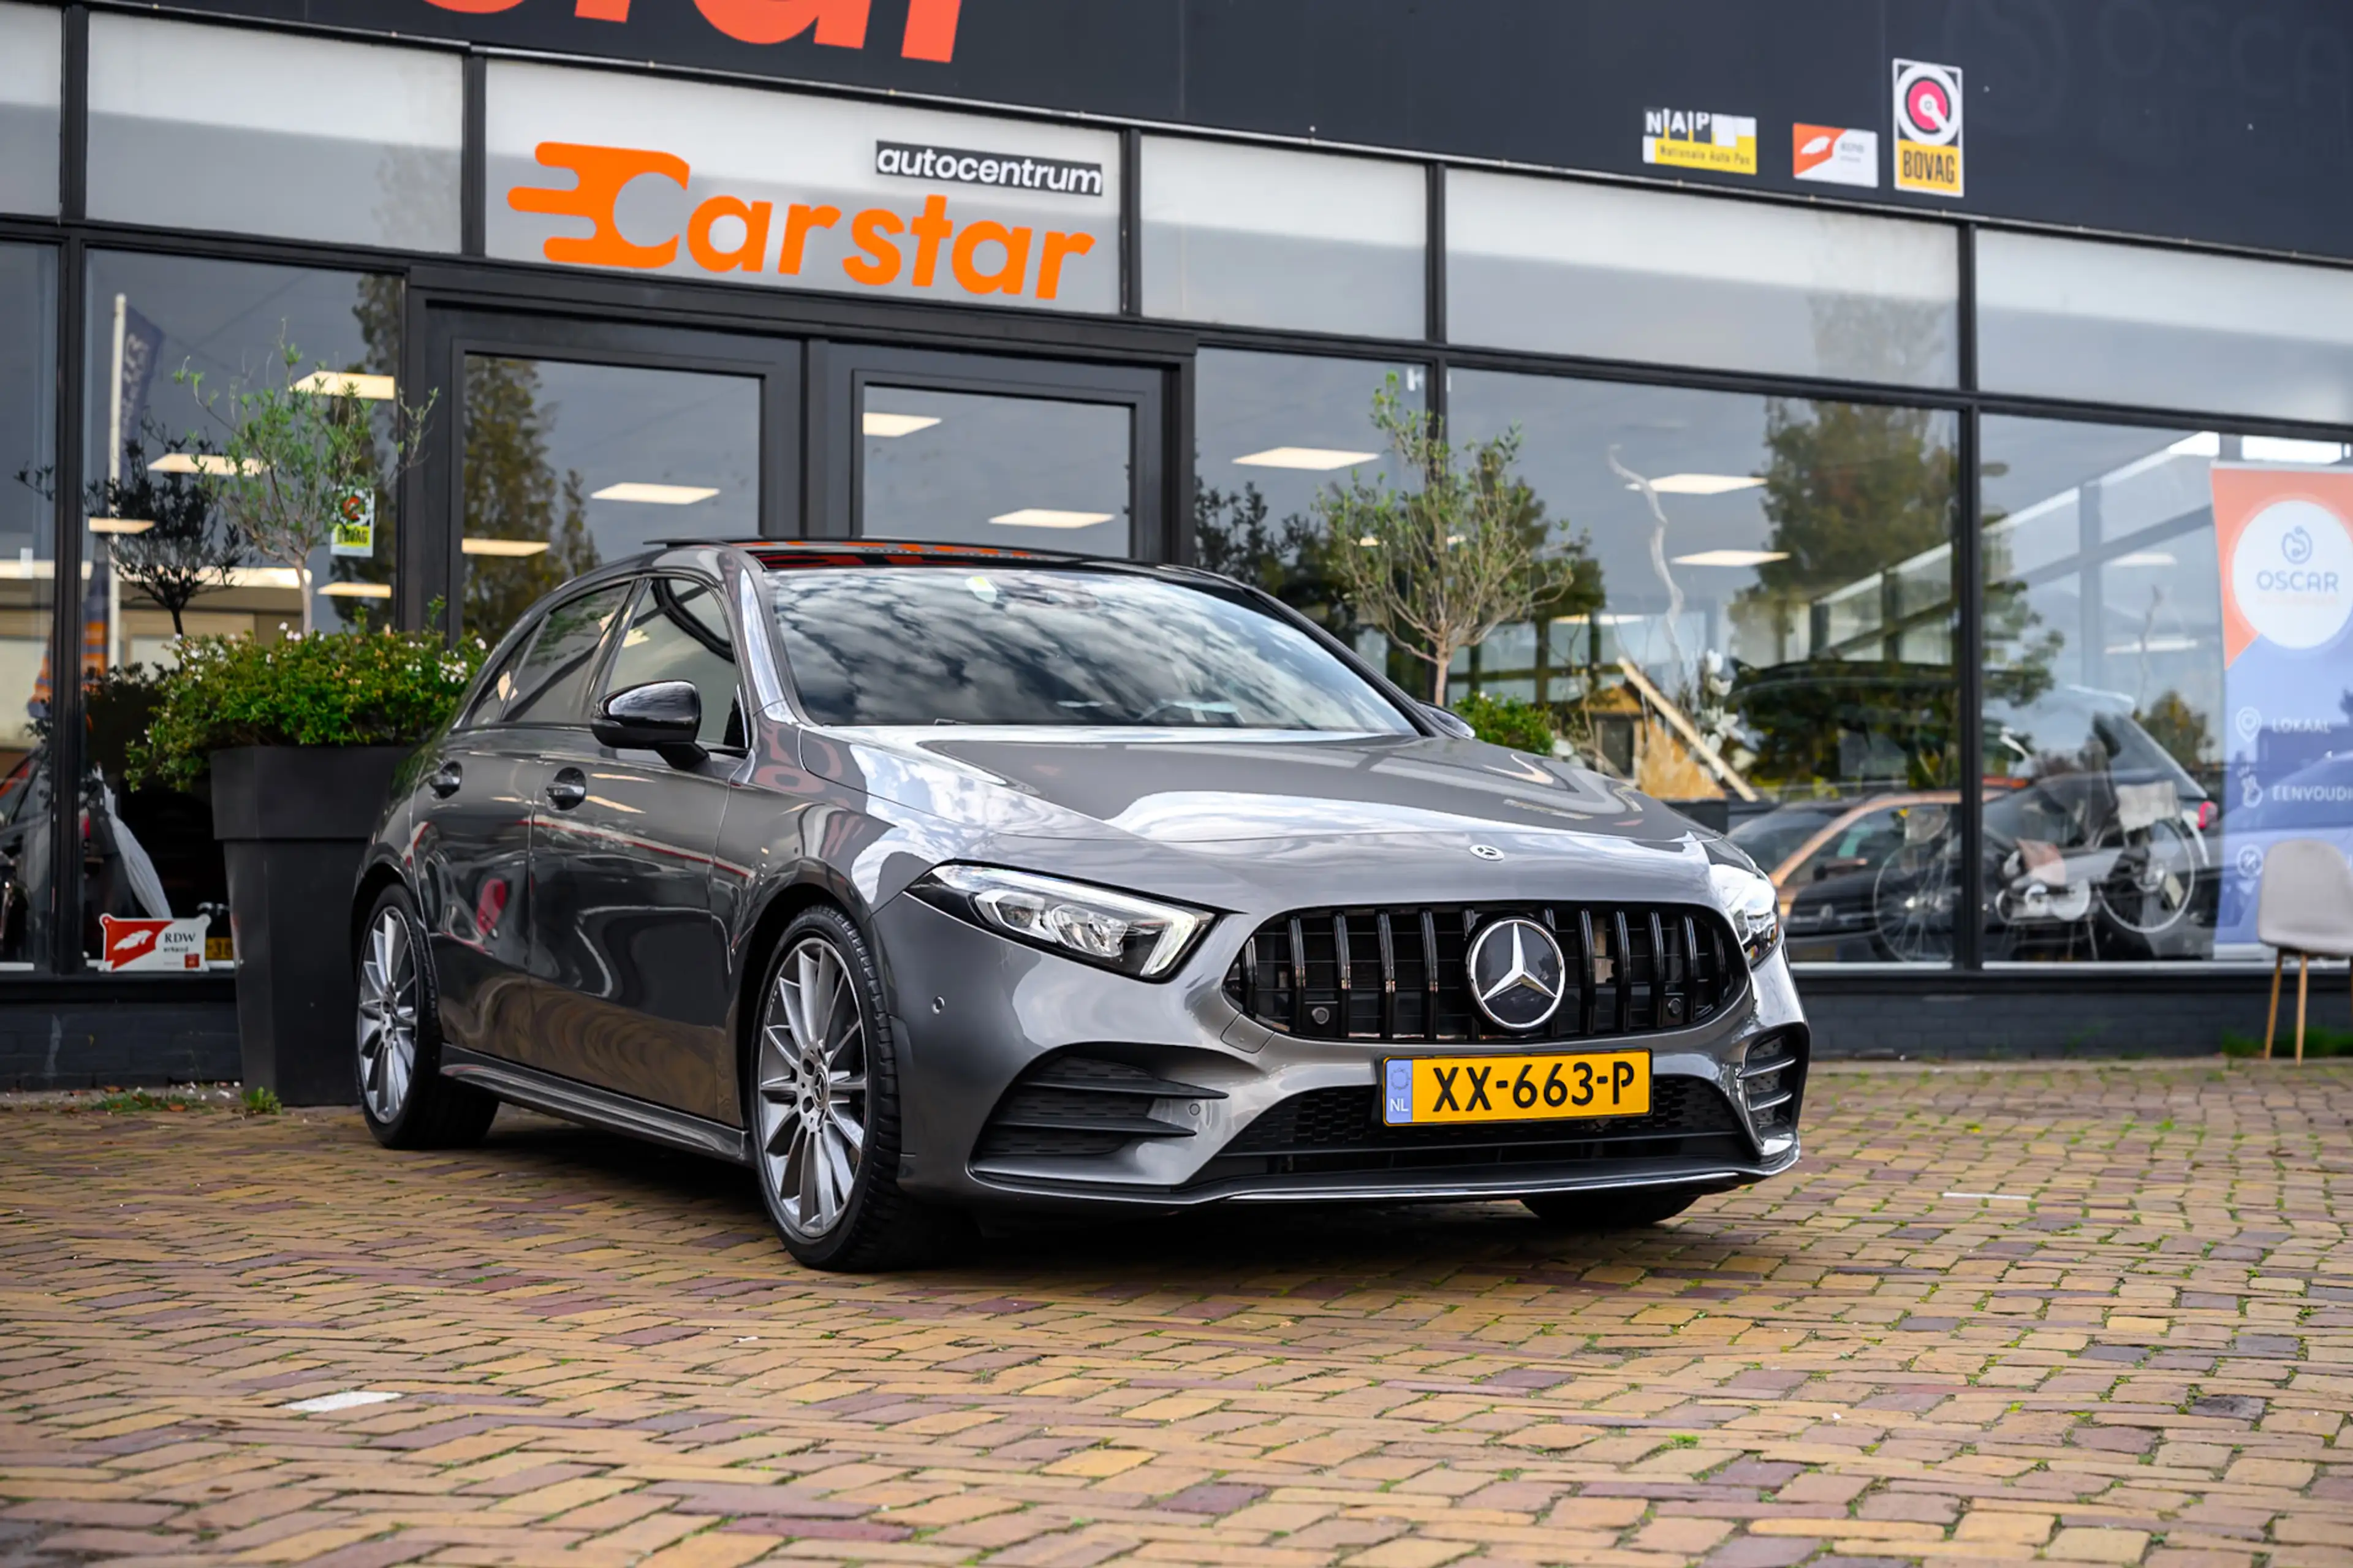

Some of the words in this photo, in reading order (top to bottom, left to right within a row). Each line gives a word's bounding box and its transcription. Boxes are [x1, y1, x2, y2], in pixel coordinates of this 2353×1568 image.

[1646, 109, 1710, 134] NAP
[877, 147, 1102, 194] autocentrum
[1903, 150, 1955, 184] BOVAG
[507, 142, 1096, 300] Carstar
[2256, 570, 2340, 594] OSCAR
[2272, 717, 2331, 733] LOKAAL
[164, 932, 195, 944] RDW
[1433, 1061, 1635, 1112] XX-663-P
[1390, 1099, 1408, 1112] NL
